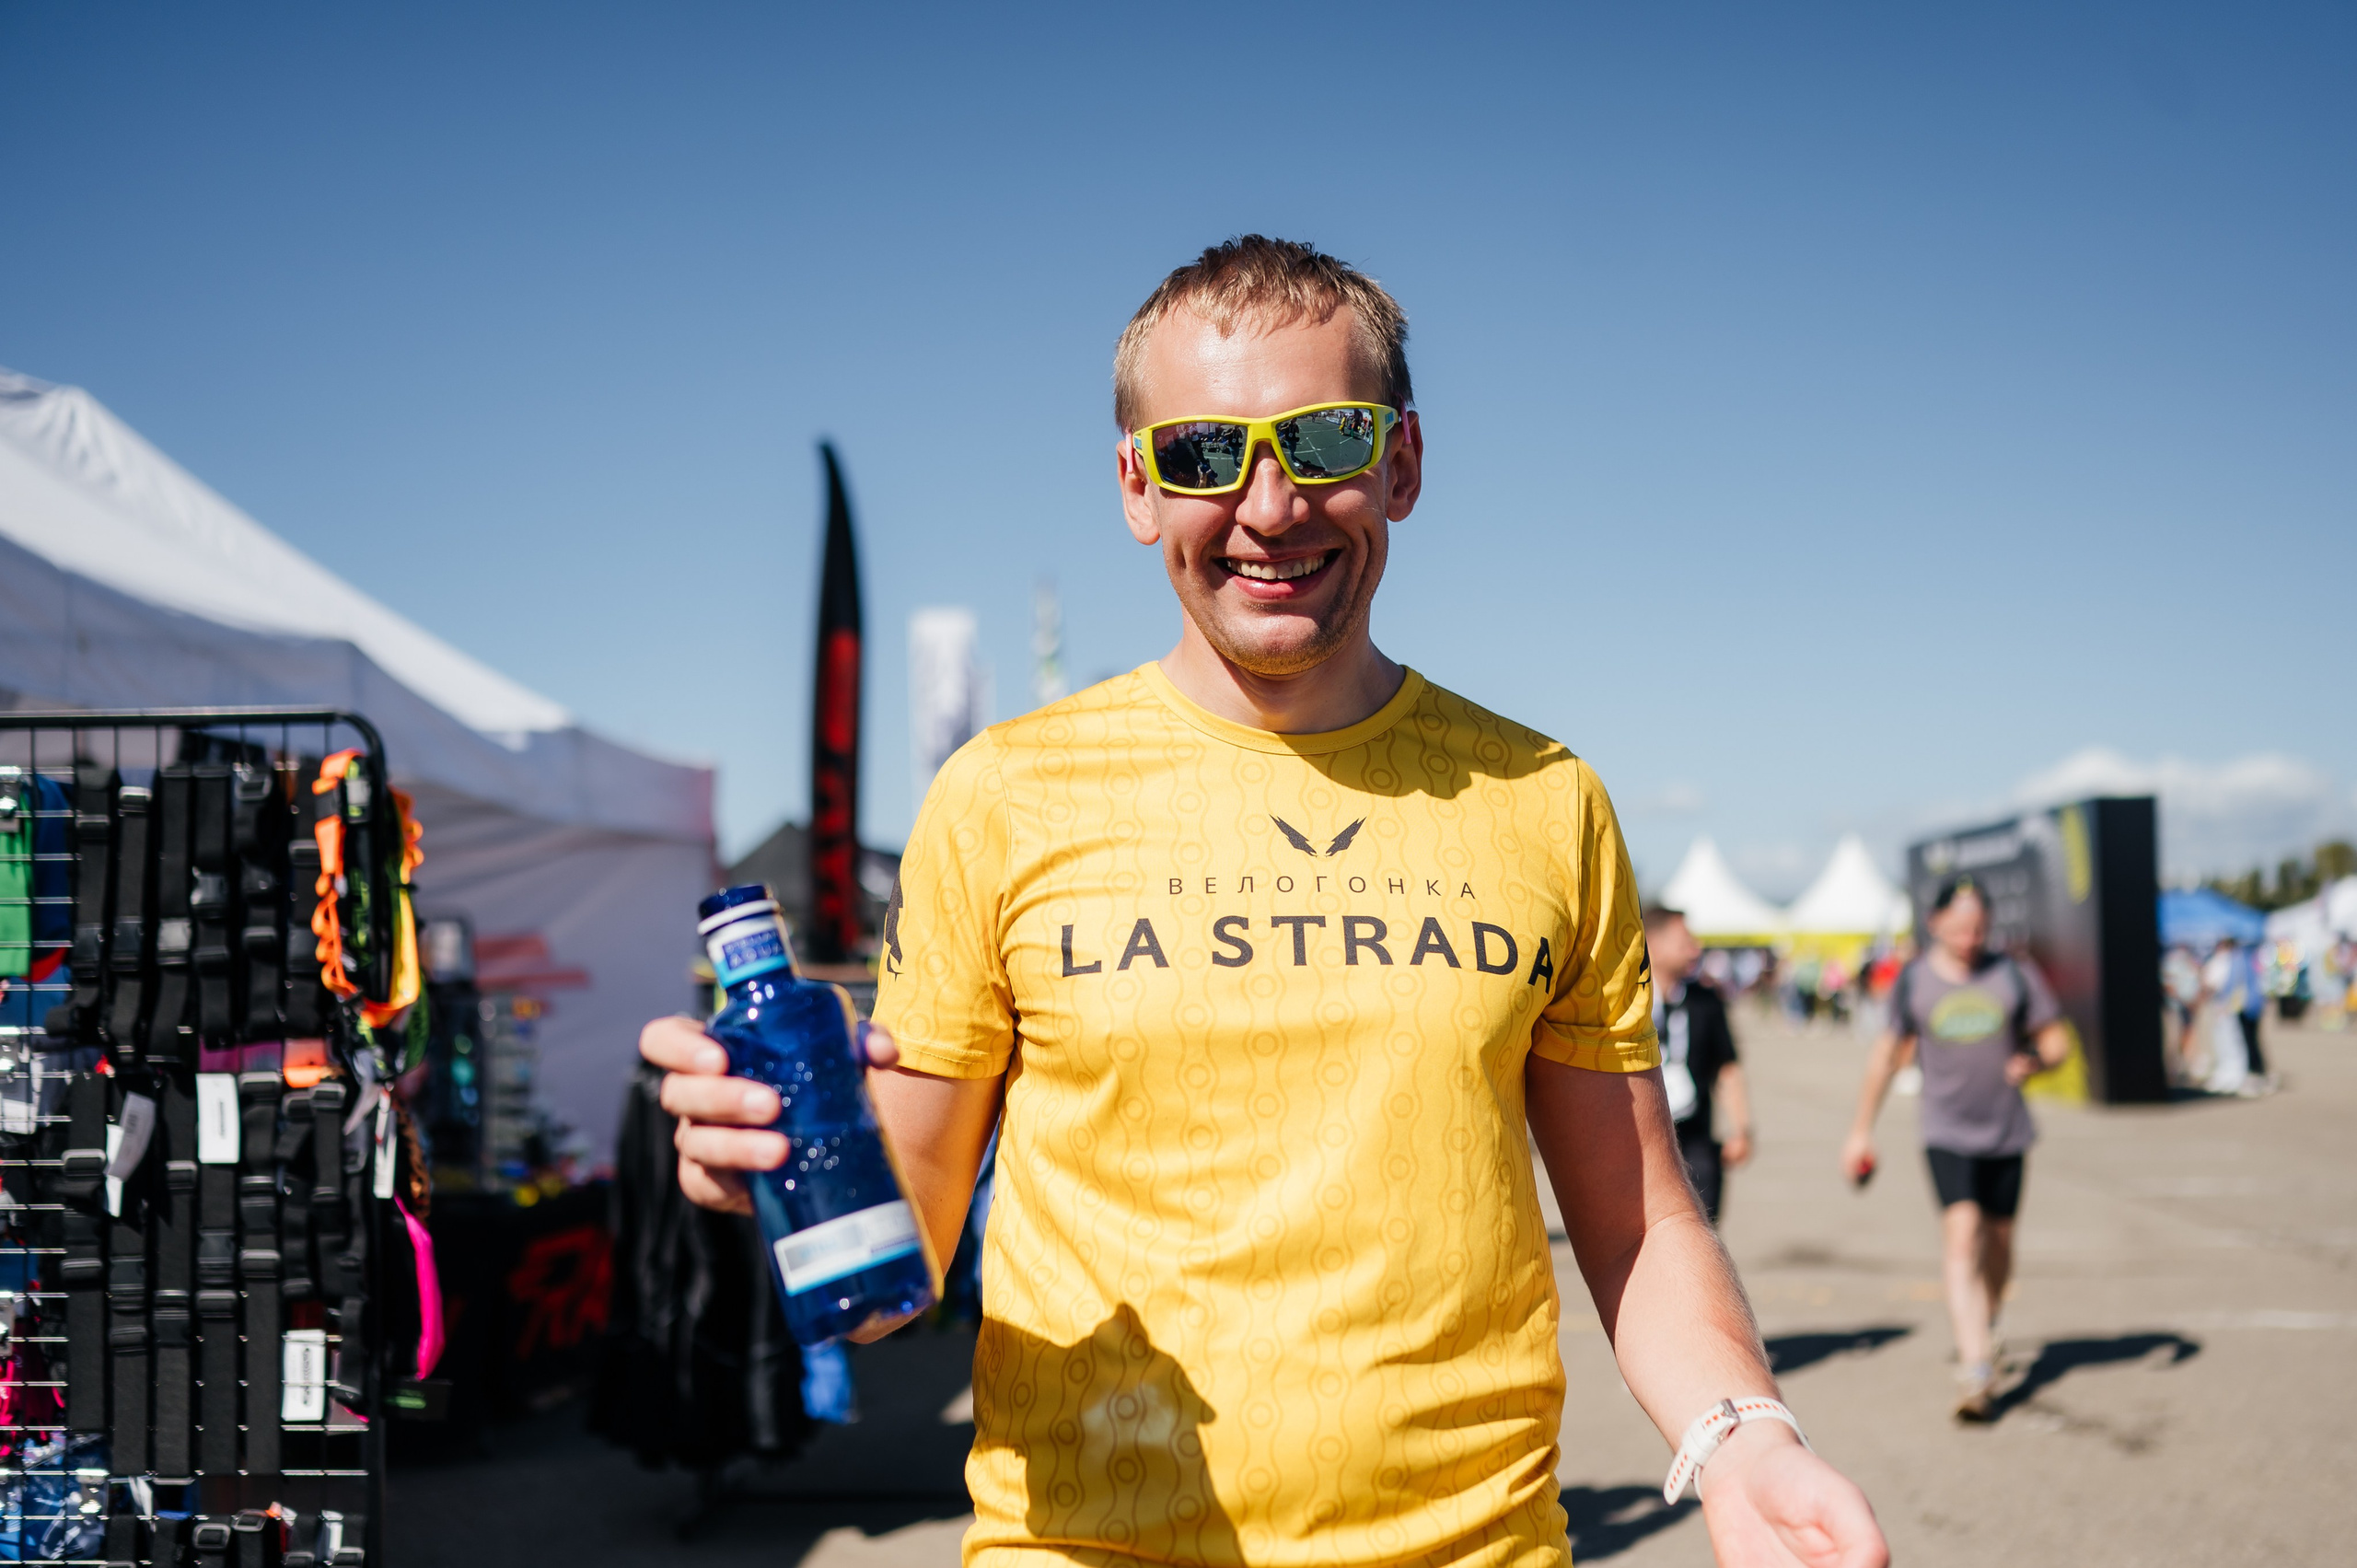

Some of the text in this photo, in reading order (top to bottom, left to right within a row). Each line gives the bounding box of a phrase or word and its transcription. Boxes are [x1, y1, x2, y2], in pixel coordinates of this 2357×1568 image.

[1168, 875, 1477, 900] ВЕЛОГОНКА
[1061, 914, 1556, 994] LA STRADA
